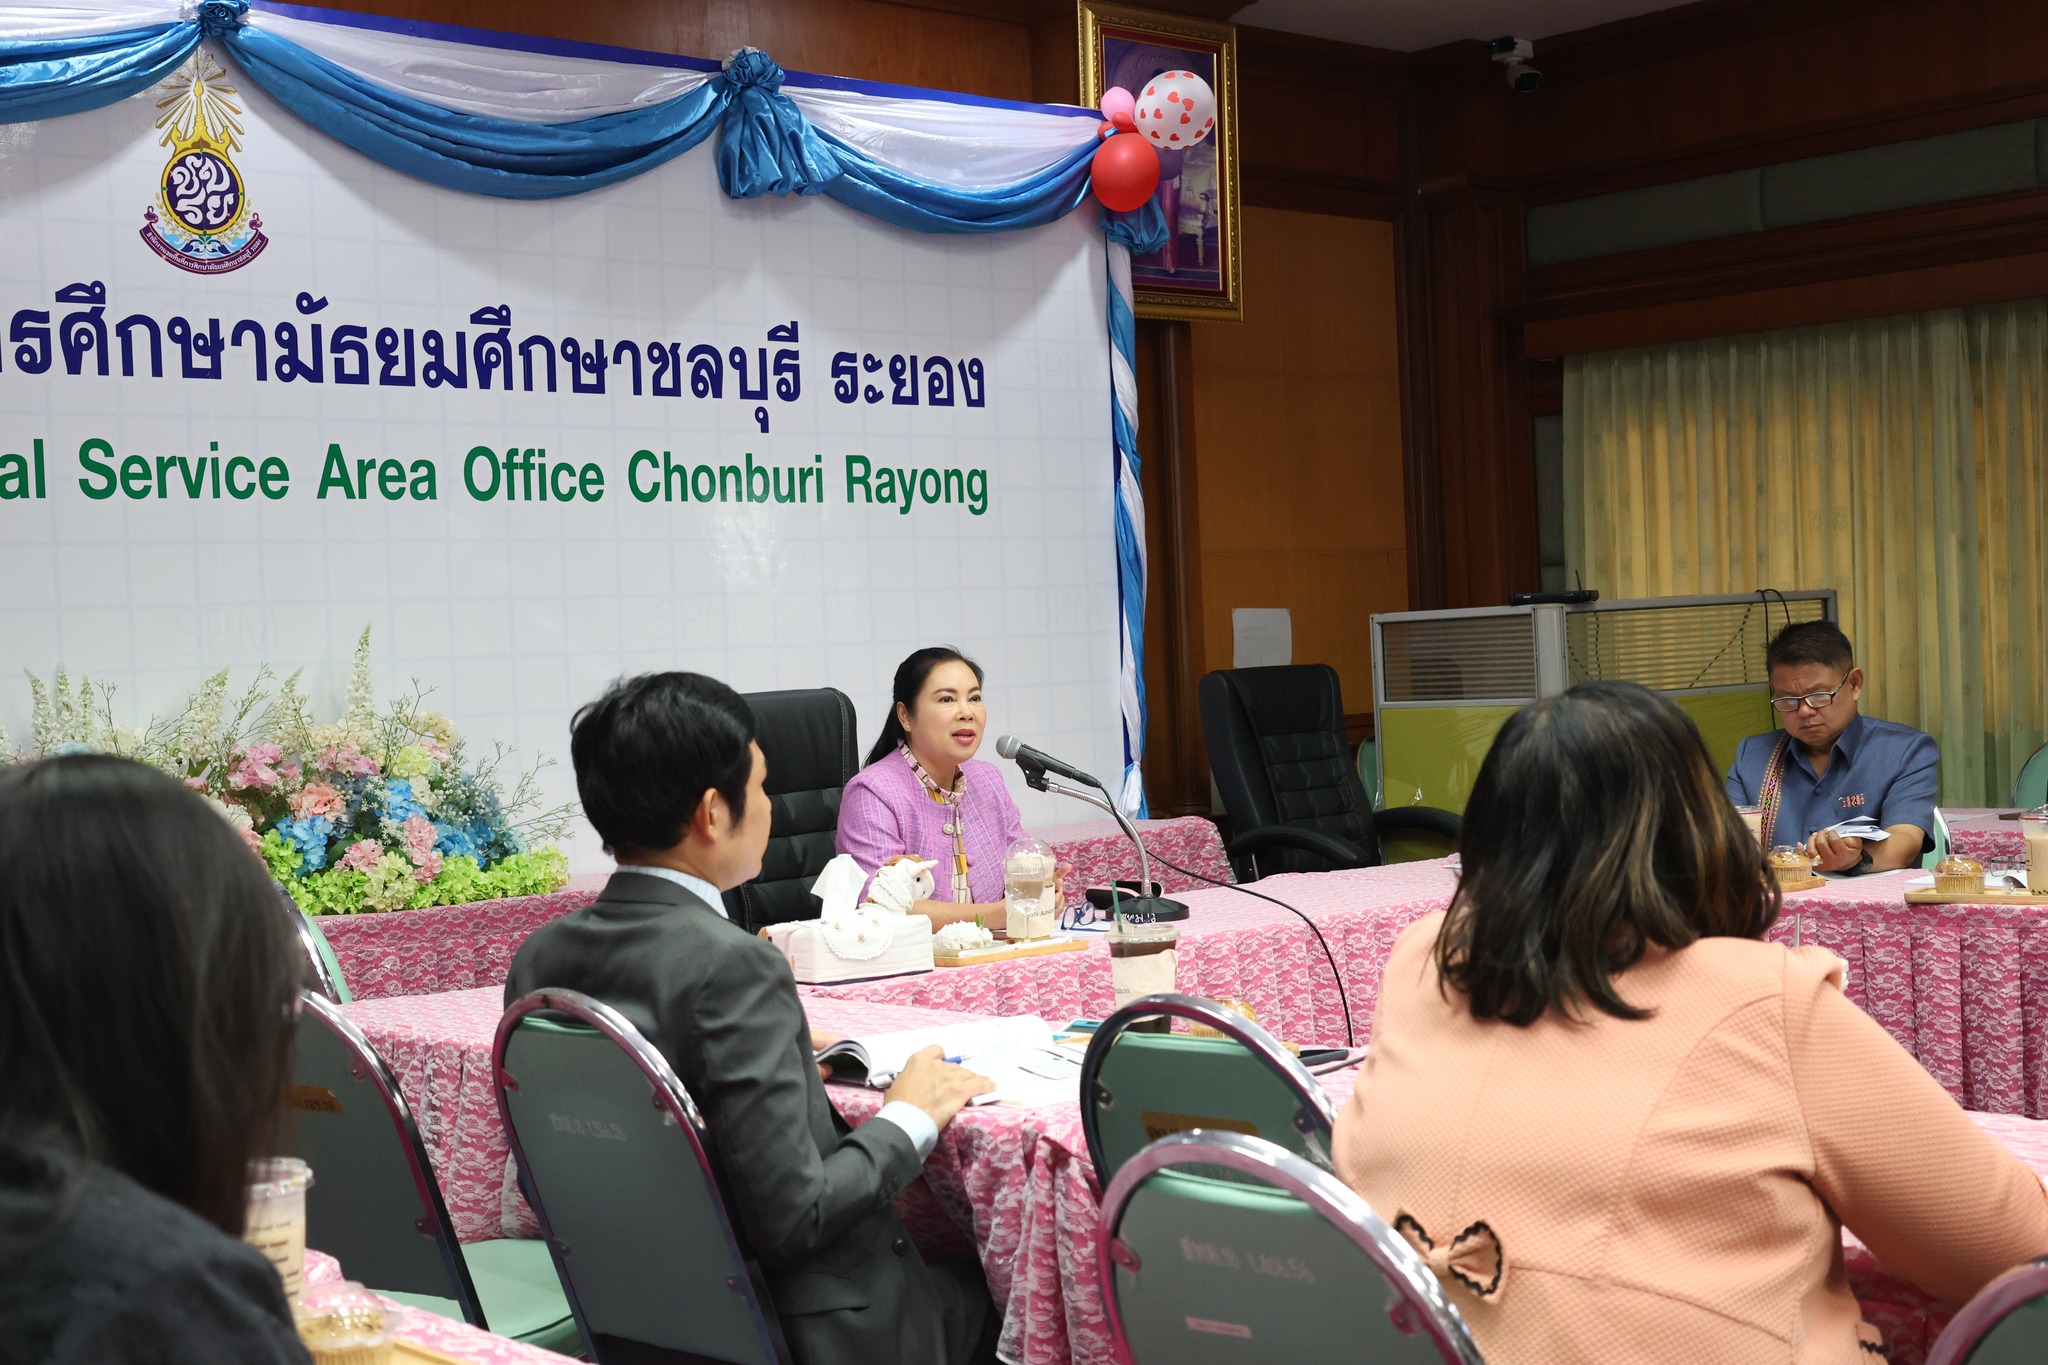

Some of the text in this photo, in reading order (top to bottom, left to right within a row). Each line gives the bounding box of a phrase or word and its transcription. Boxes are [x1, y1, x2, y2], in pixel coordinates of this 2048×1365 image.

[0, 281, 984, 433] รศึกษามัธยมศึกษาชลบุรี ระยอง
[79, 438, 289, 499] Service
[317, 444, 436, 500] Area
[464, 446, 604, 502] Office
[629, 450, 823, 502] Chonburi
[846, 455, 987, 515] Rayong
